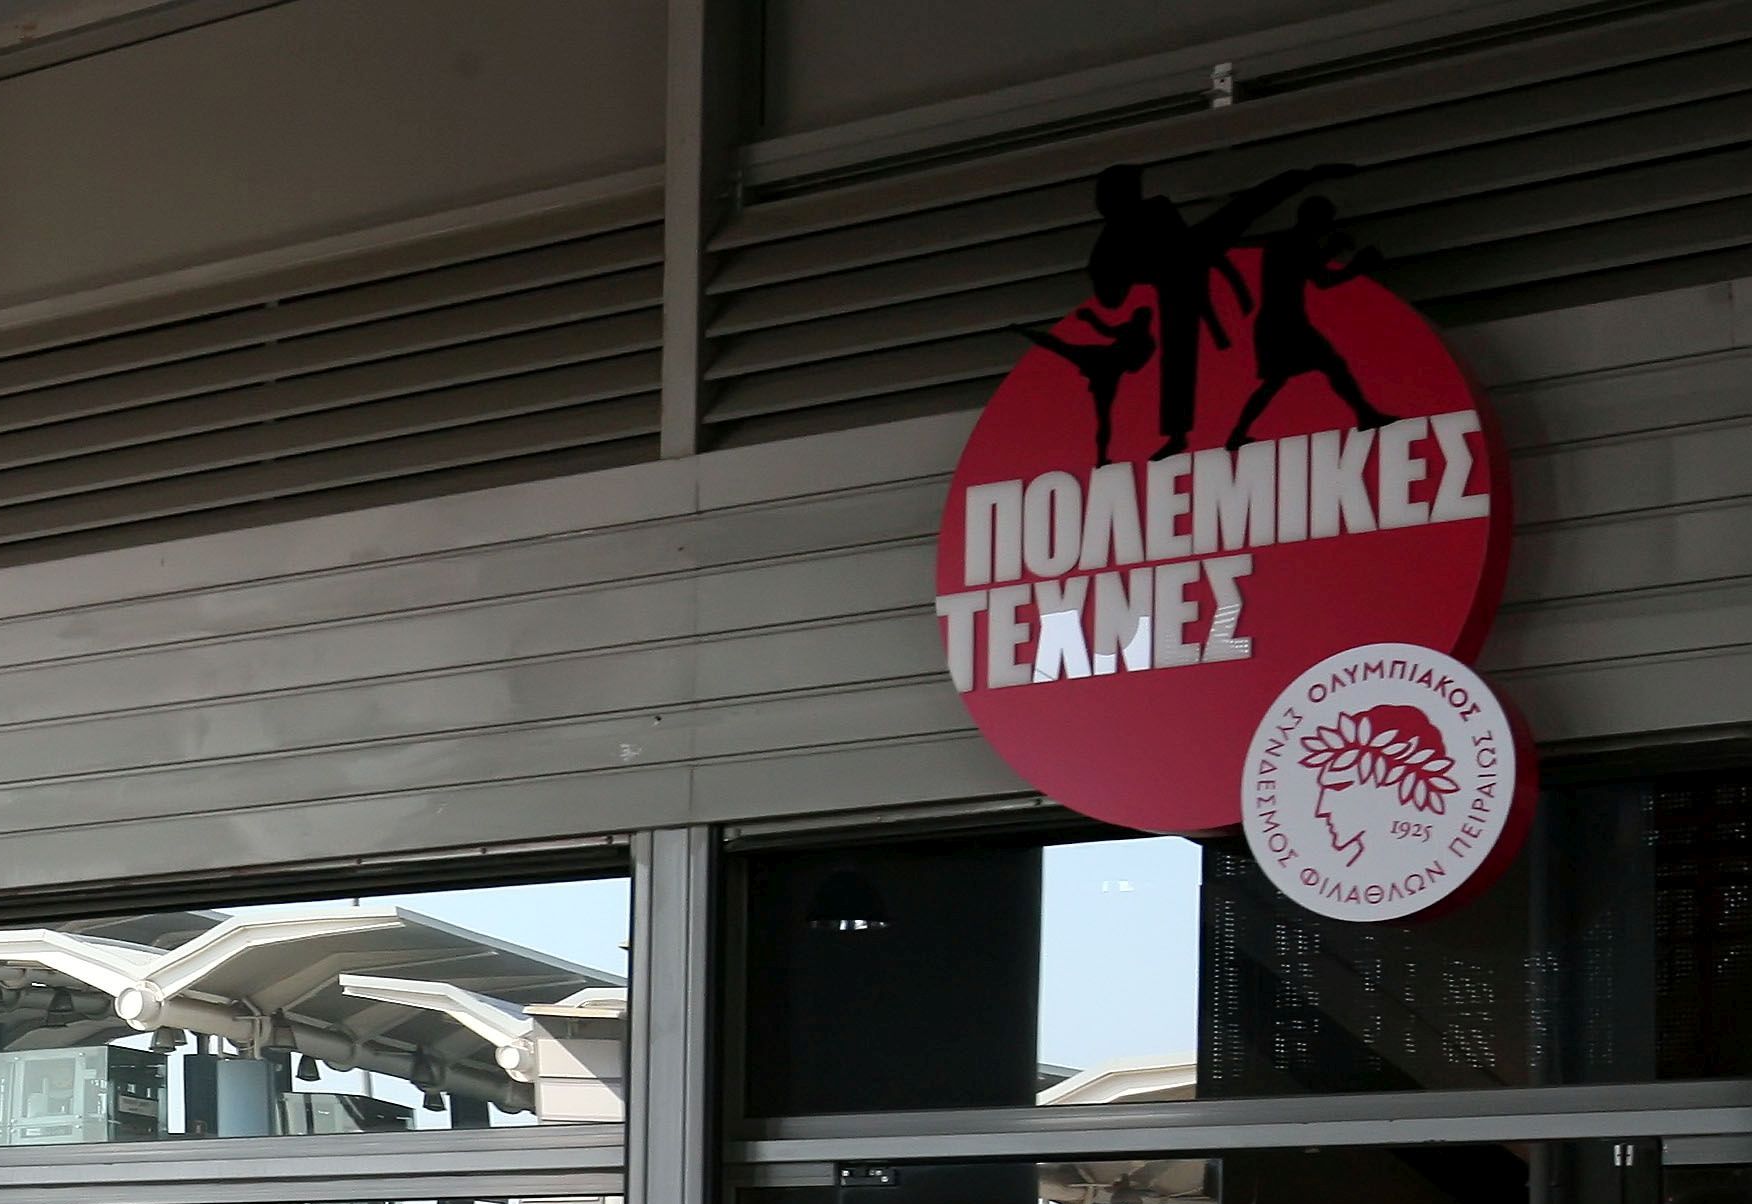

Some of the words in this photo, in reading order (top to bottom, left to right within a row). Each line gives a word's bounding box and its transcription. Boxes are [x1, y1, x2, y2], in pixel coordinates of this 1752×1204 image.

[965, 409, 1490, 587] ΠΟΛΕΜΙΚΕΣ
[936, 554, 1253, 695] ΤΕΧΝΕΣ
[1308, 660, 1482, 722] ΟΛΥΜΠΙΑΚΟΣ
[1256, 707, 1303, 868] ΣΥΝΔΕΣΜΟΣ
[1300, 860, 1447, 904] ΦΙΛΑΘΛΩΝ
[1448, 730, 1497, 858] ΠΕΙΡΑΙΩΣ
[1390, 820, 1432, 842] 1925
